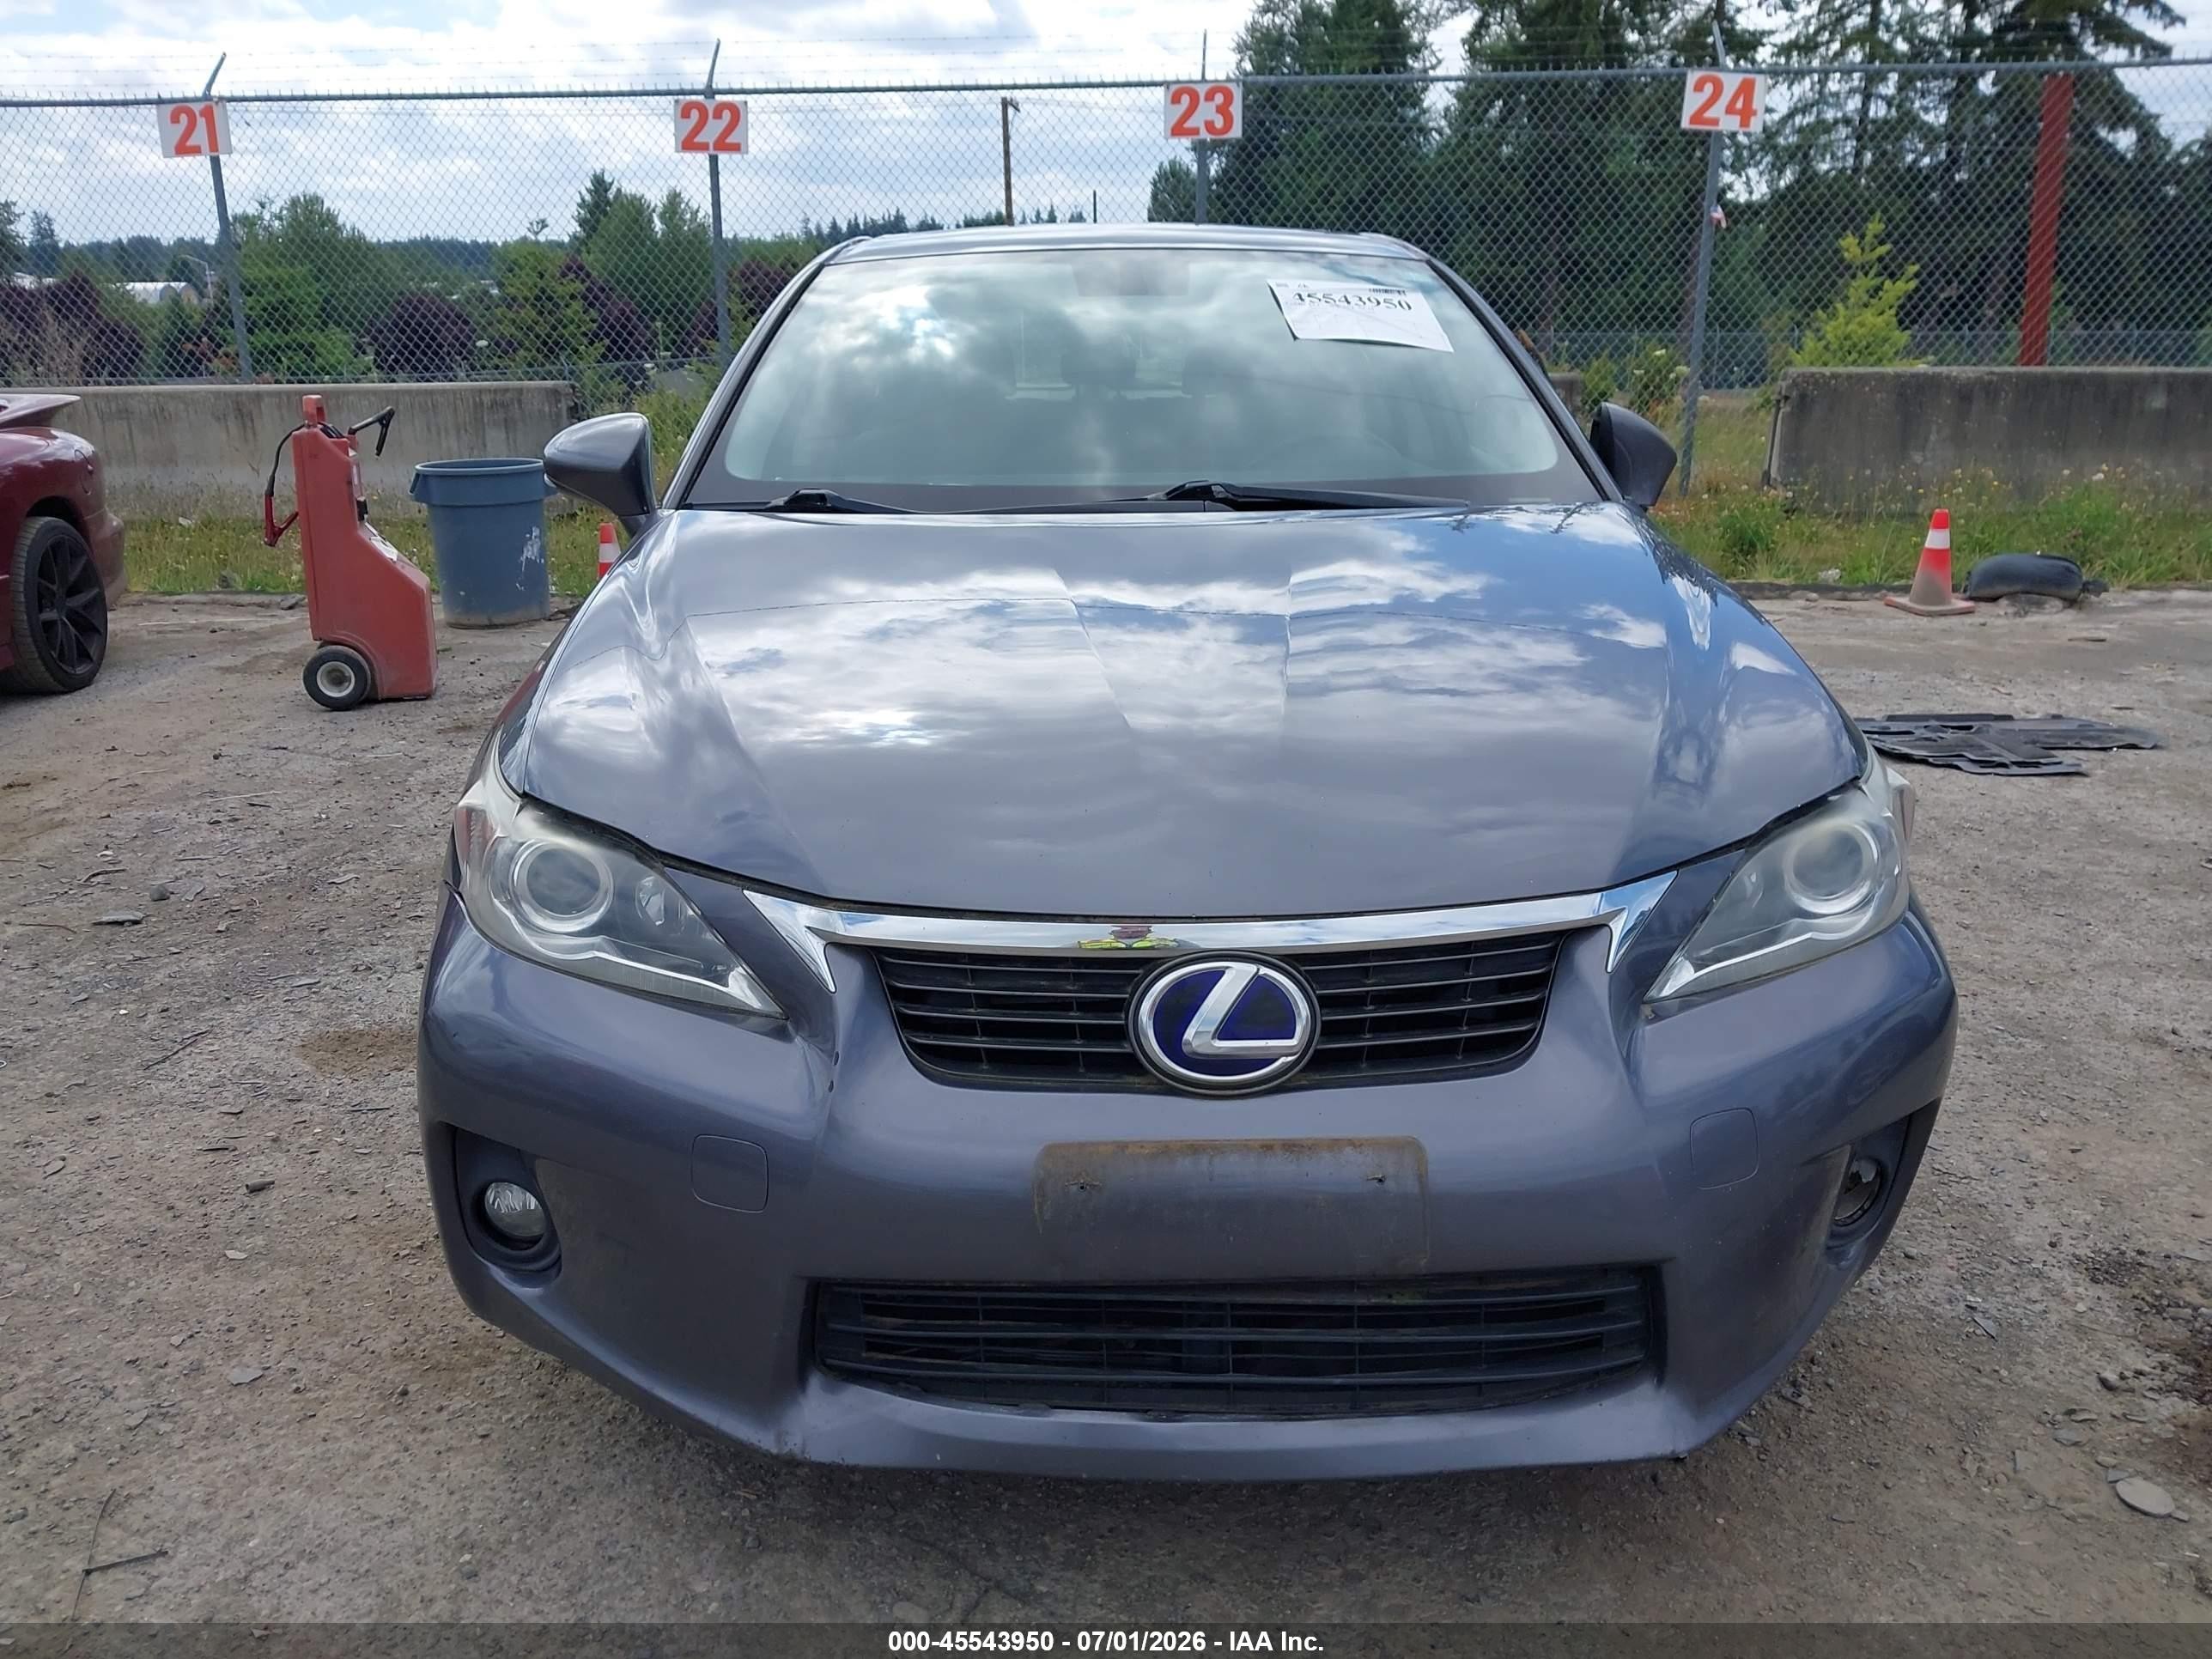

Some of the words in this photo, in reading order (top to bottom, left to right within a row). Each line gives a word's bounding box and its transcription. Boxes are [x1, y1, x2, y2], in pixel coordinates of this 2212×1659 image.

[680, 101, 741, 152] 22
[1170, 85, 1234, 137] 23
[1688, 75, 1757, 129] 24
[170, 105, 219, 155] 21
[1292, 292, 1413, 312] 45543950
